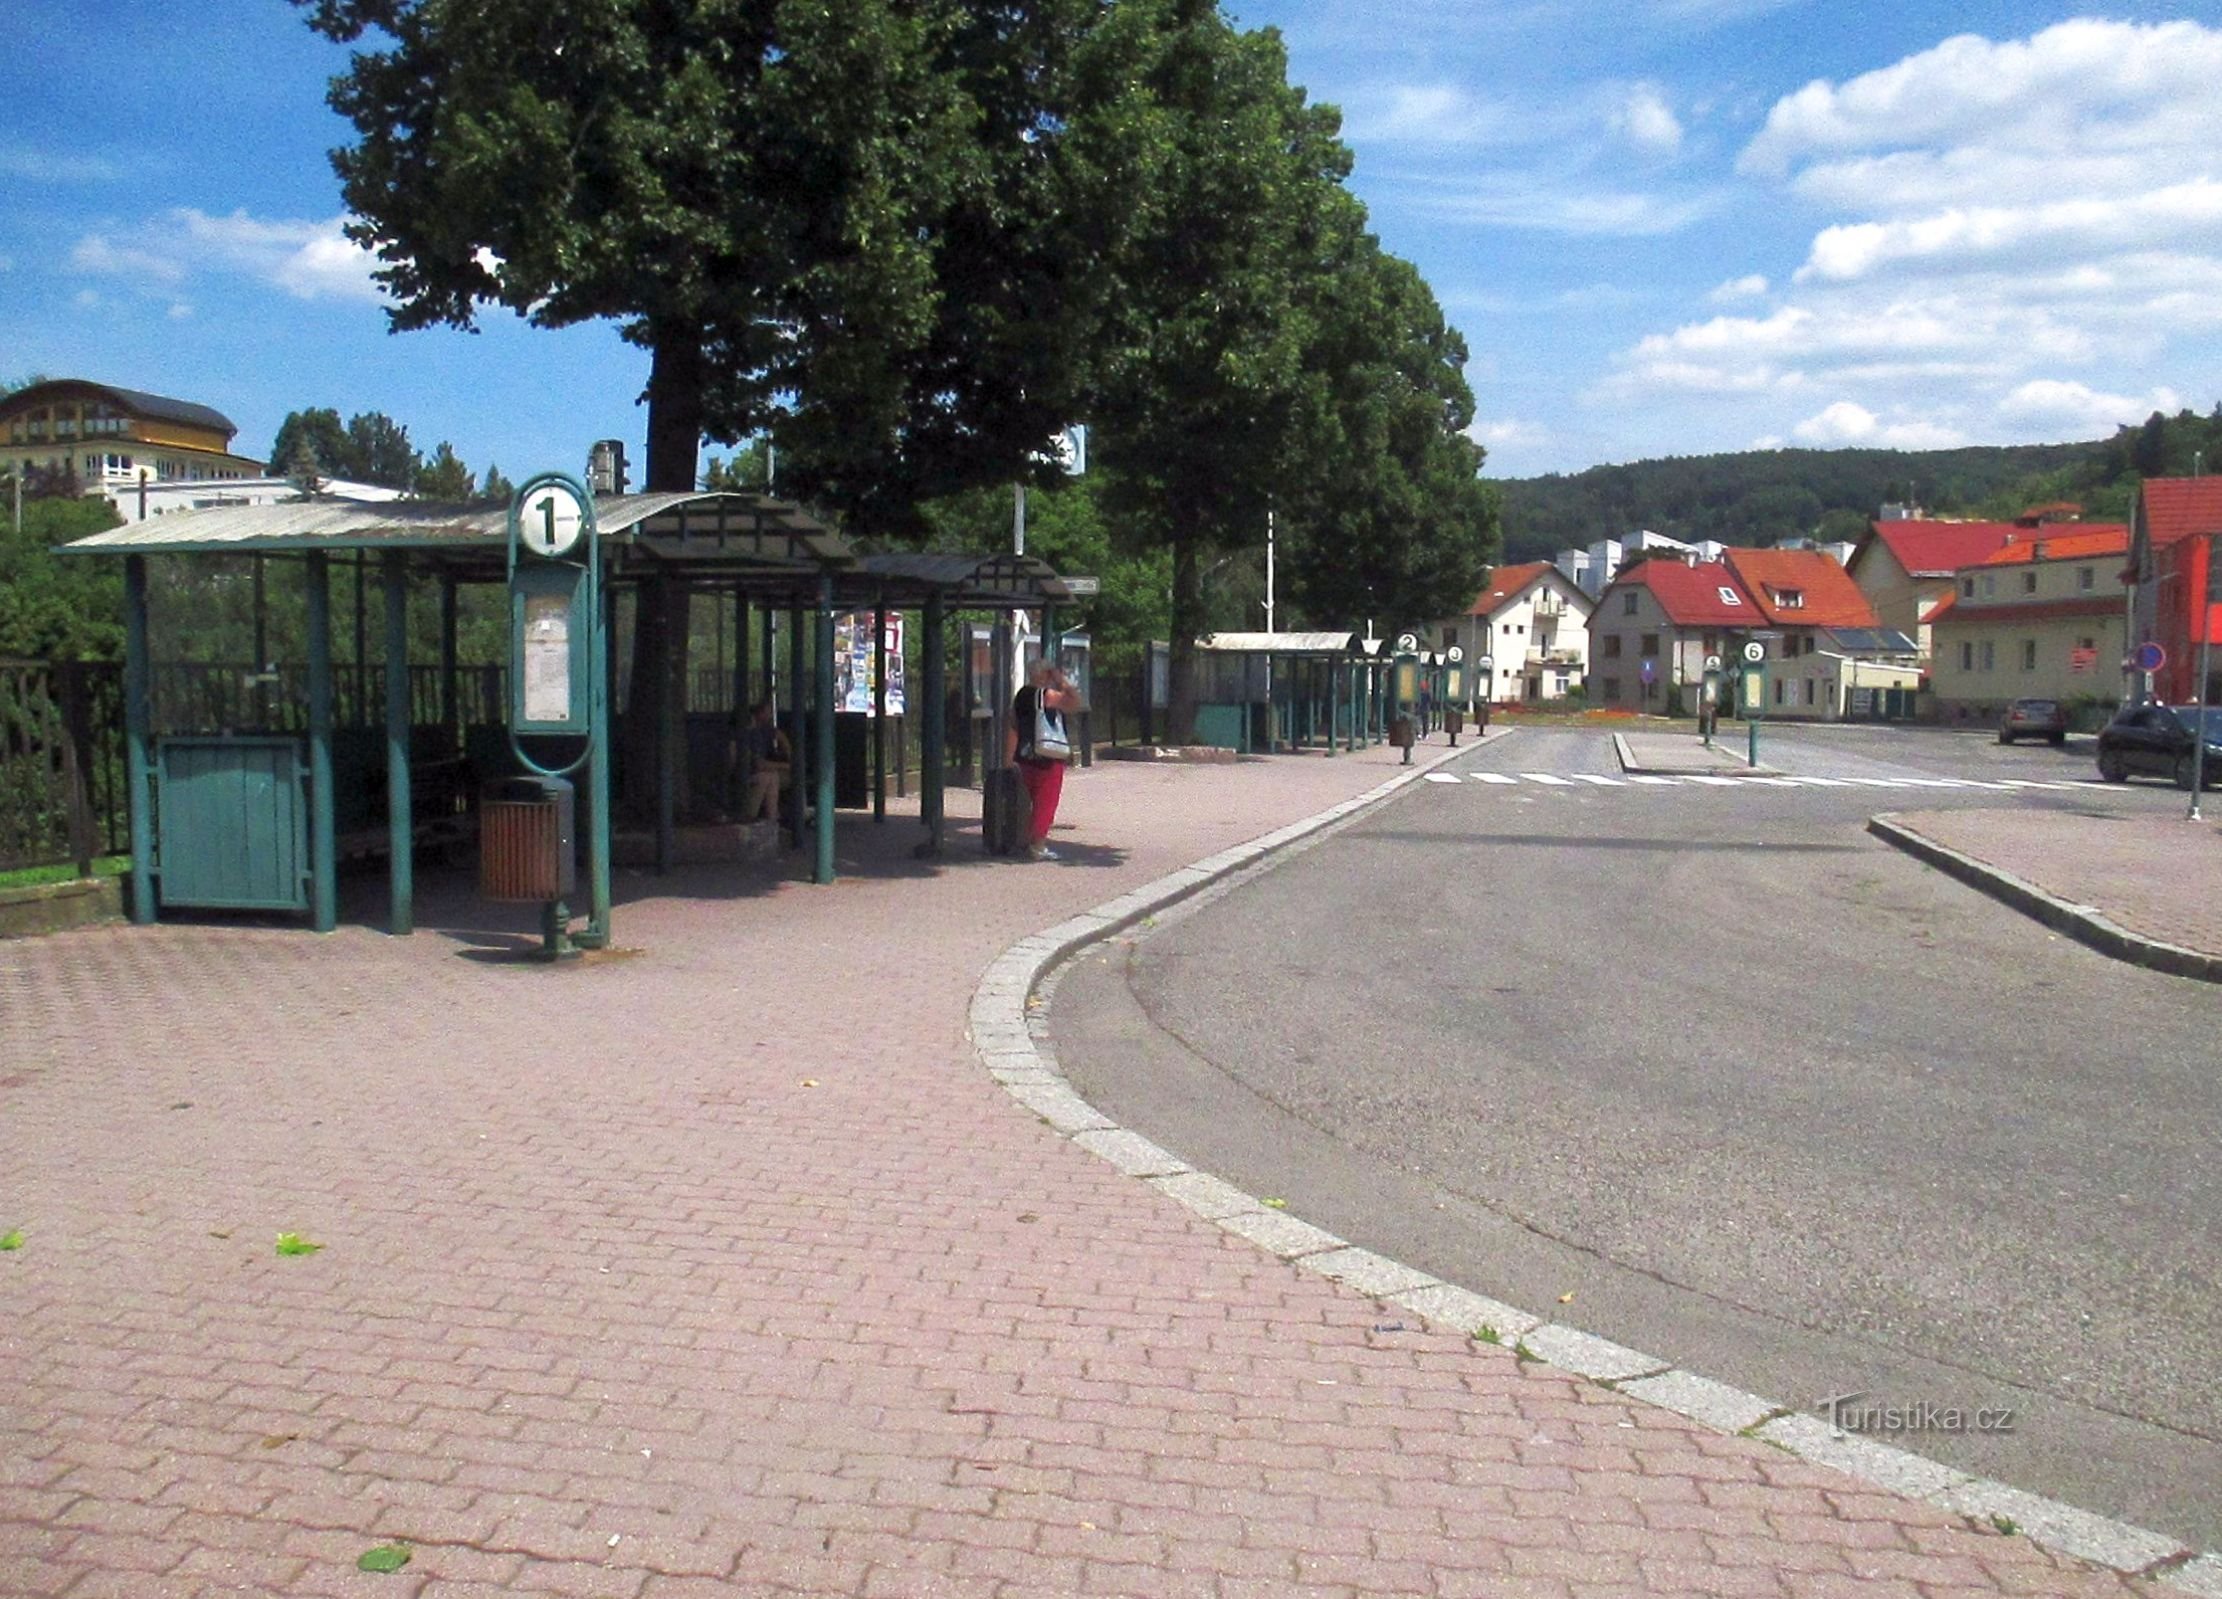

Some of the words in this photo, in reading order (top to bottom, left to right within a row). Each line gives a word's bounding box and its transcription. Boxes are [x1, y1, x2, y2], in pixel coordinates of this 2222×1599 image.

[536, 496, 555, 545] 1
[1403, 635, 1413, 650] 2
[1451, 649, 1459, 660] 3
[1750, 645, 1759, 659] 6
